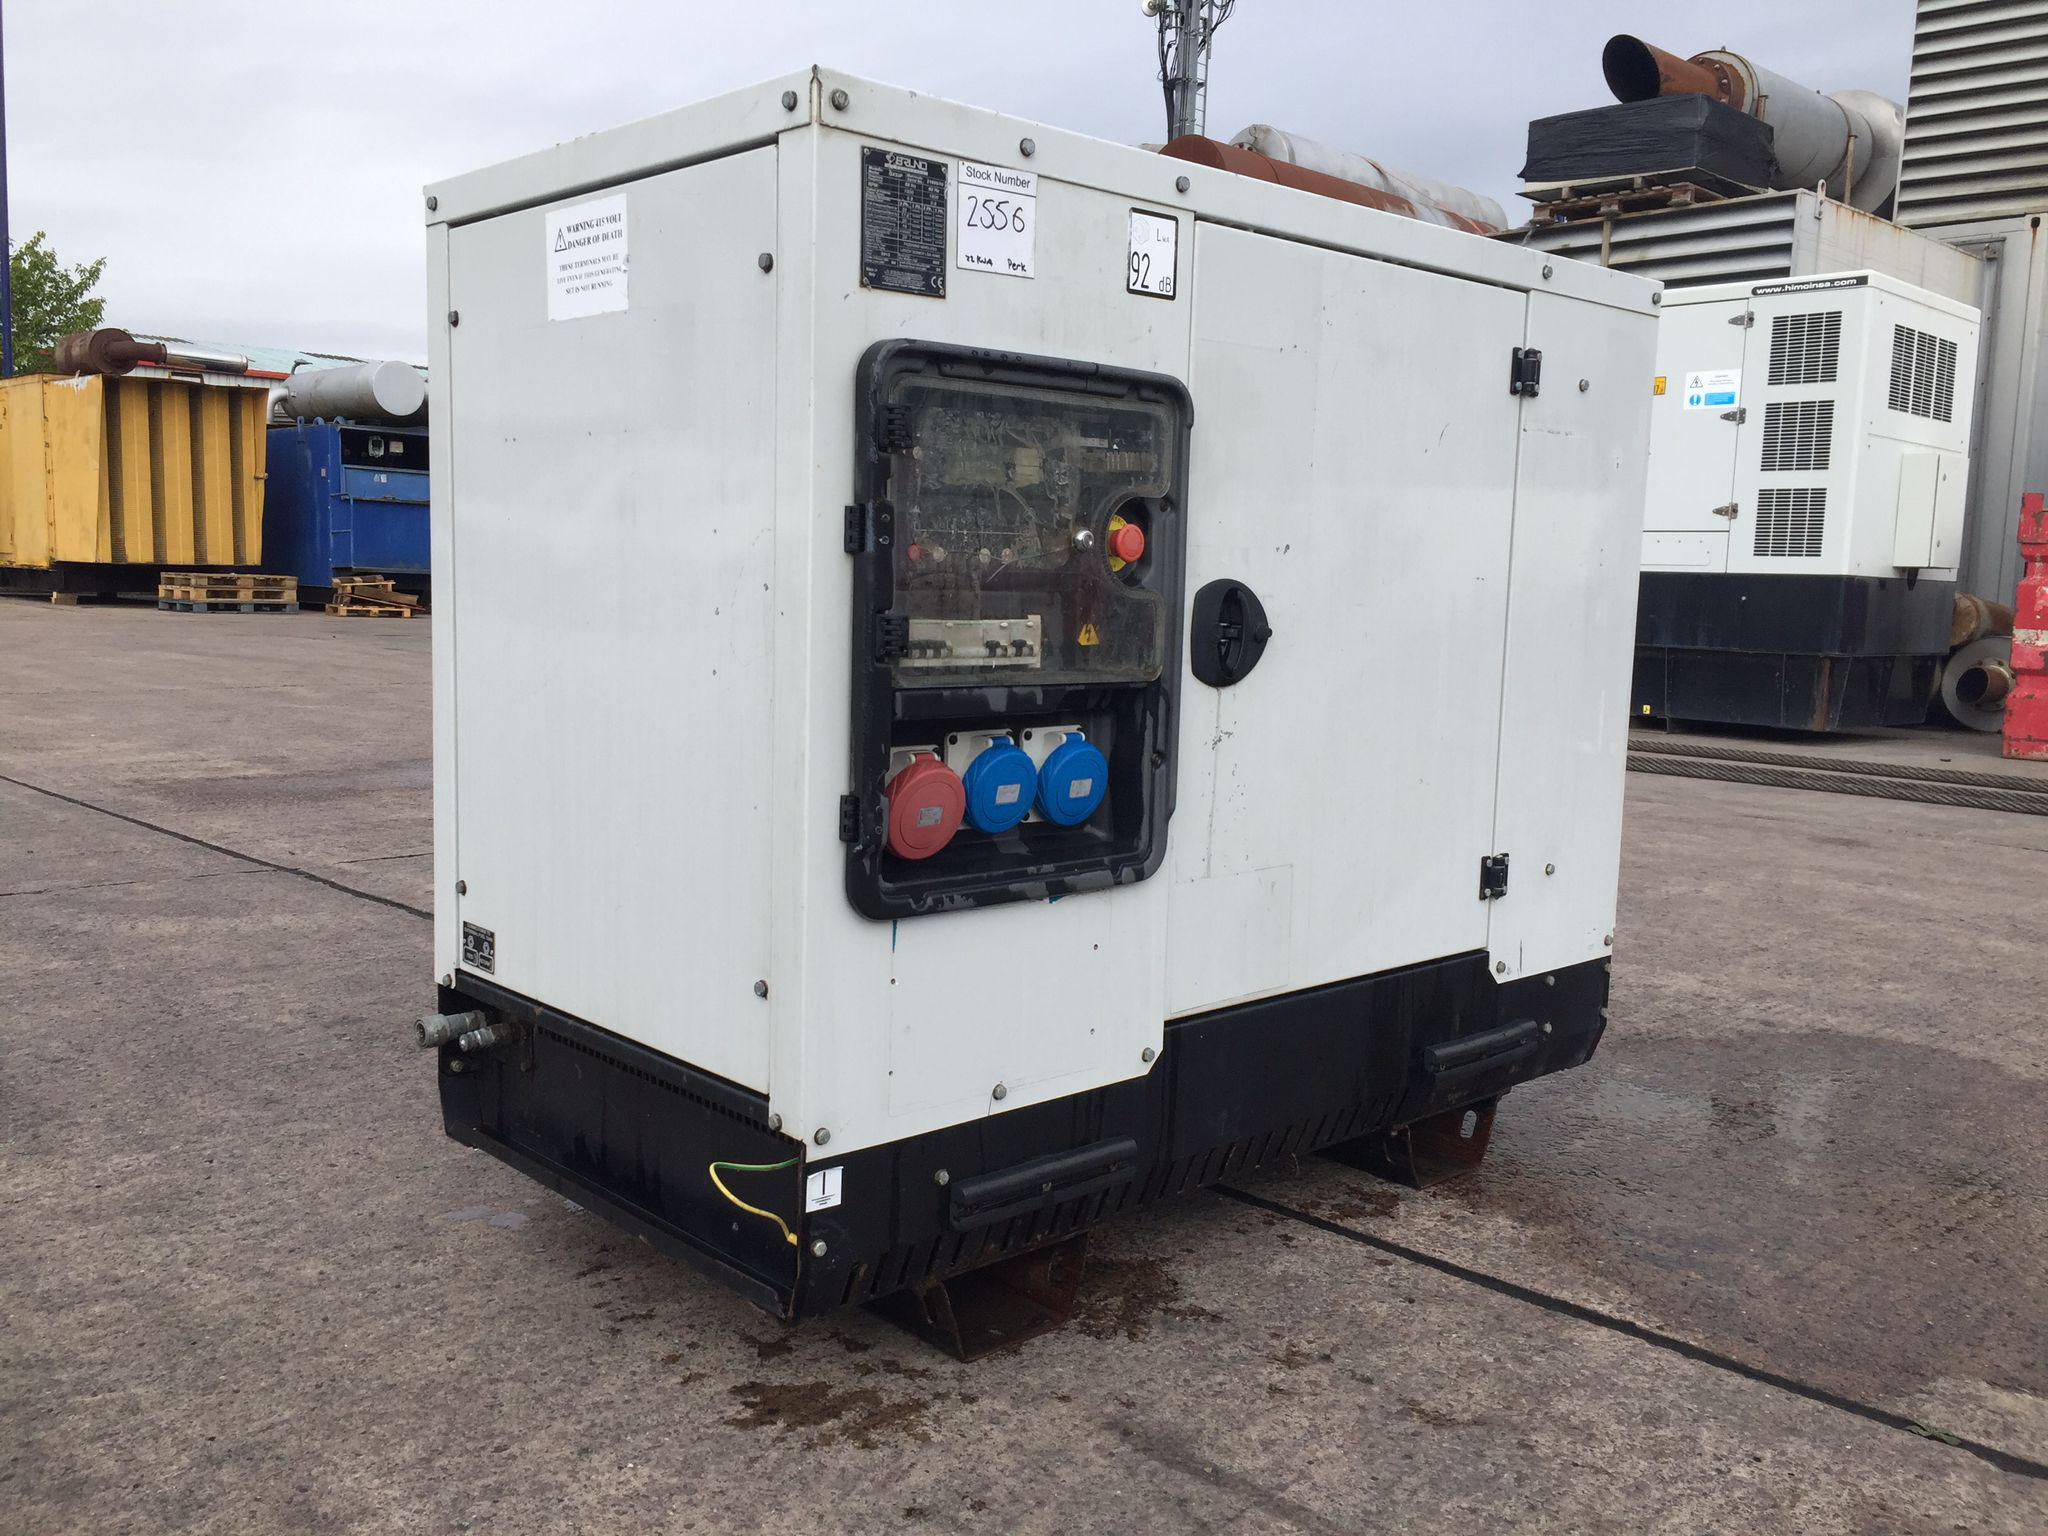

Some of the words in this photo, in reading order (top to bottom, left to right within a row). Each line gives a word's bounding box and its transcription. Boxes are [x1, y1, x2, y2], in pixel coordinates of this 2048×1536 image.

[896, 156, 928, 171] BRUNO
[966, 165, 991, 181] Stock
[995, 171, 1031, 188] Number
[566, 219, 594, 234] WARNING
[606, 212, 622, 225] VOLT
[967, 195, 1025, 233] 2556
[567, 236, 592, 250] DANGER
[592, 234, 600, 244] OF
[601, 229, 623, 242] DEATH
[1007, 257, 1026, 272] Perk
[1131, 251, 1150, 289] 92
[1159, 276, 1172, 293] dB
[1755, 278, 1857, 295] www.himoinsa.com
